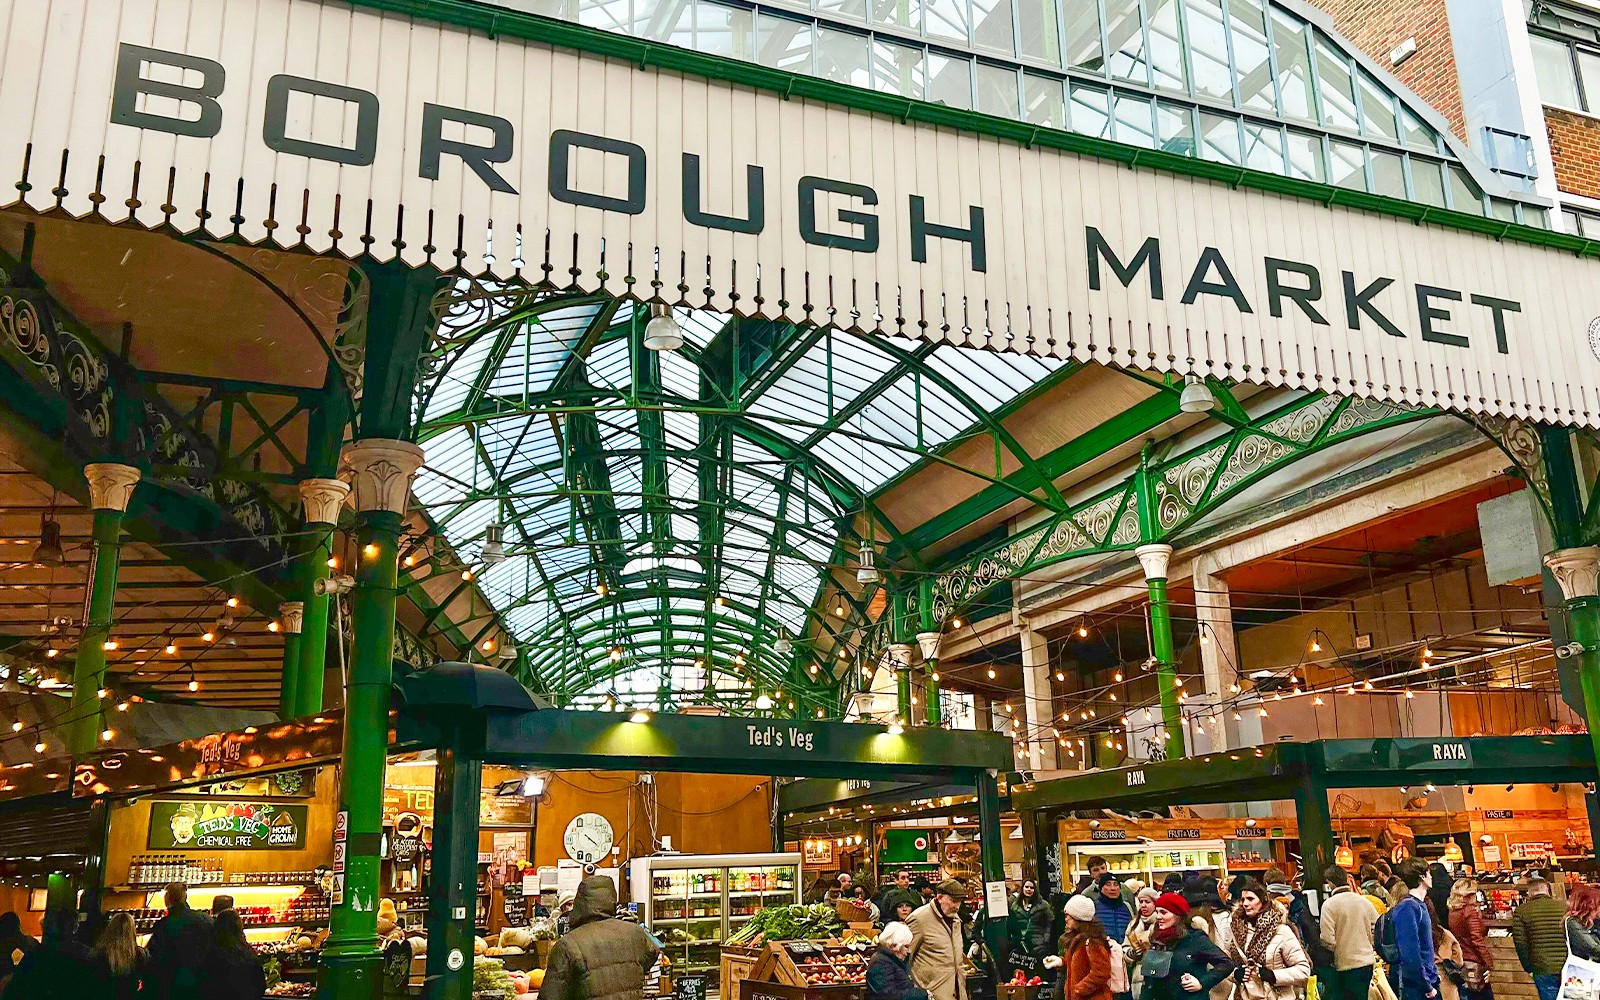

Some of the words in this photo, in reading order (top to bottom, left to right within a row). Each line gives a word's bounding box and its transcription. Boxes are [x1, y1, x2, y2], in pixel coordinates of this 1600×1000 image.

[110, 42, 987, 272] BOROUGH
[1085, 226, 1522, 354] MARKET
[747, 725, 783, 747] Ted's
[789, 727, 813, 750] Veg
[201, 743, 222, 764] Ted's
[224, 739, 241, 761] Veg
[1433, 744, 1466, 760] RAYA
[1127, 770, 1145, 786] RAYA
[238, 816, 261, 834] VEG
[272, 826, 292, 834] HOME
[1236, 828, 1261, 837] NOODLES
[197, 835, 233, 846] CHEMICAL
[235, 836, 252, 846] FREE
[1168, 830, 1183, 838] FRUIT
[1188, 830, 1199, 838] VEG
